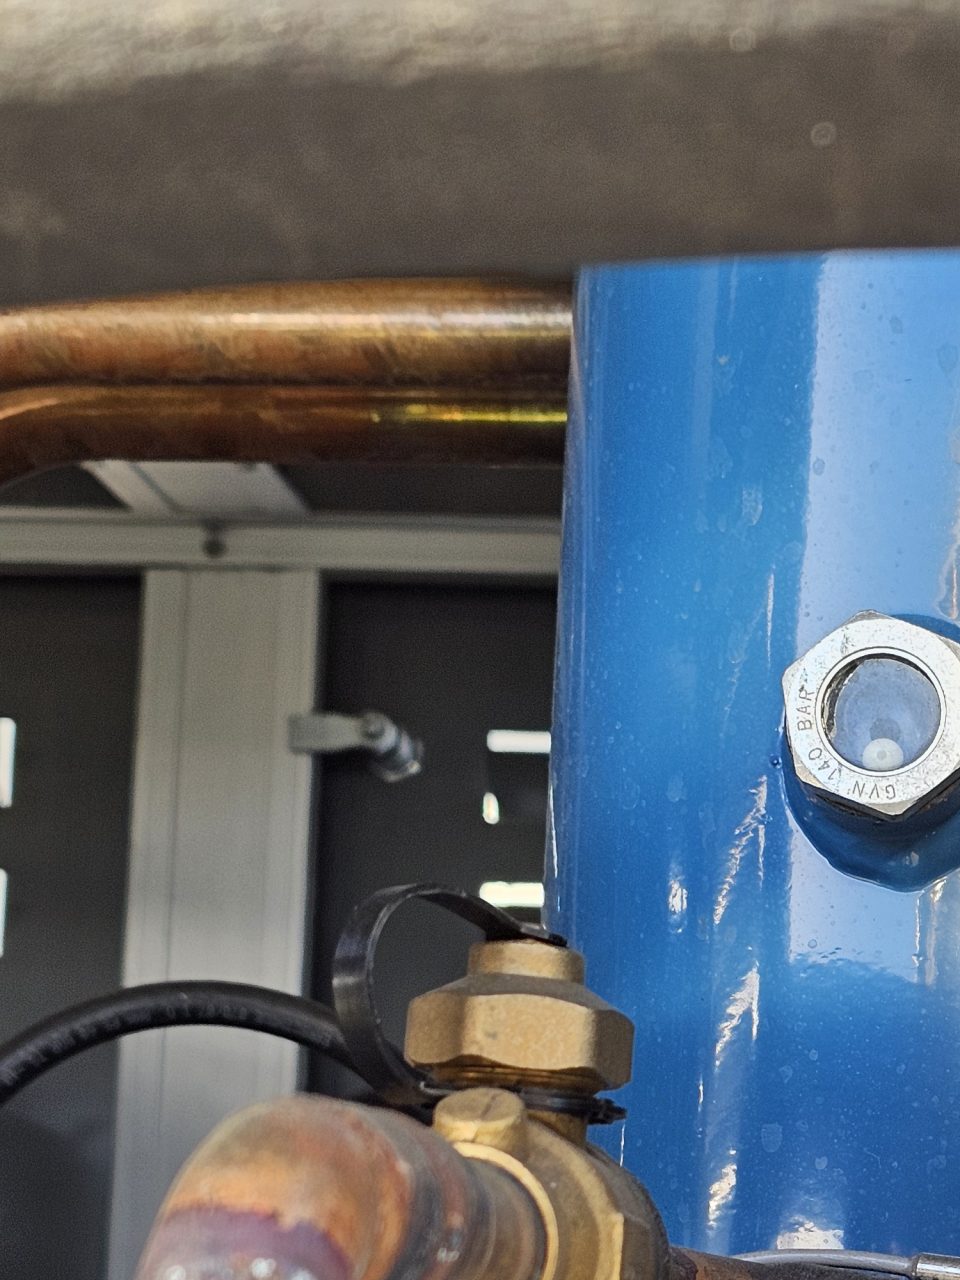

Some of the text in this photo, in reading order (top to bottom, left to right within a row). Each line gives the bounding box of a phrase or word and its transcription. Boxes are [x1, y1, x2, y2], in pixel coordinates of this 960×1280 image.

[797, 690, 895, 800] GVN 140 BAR
